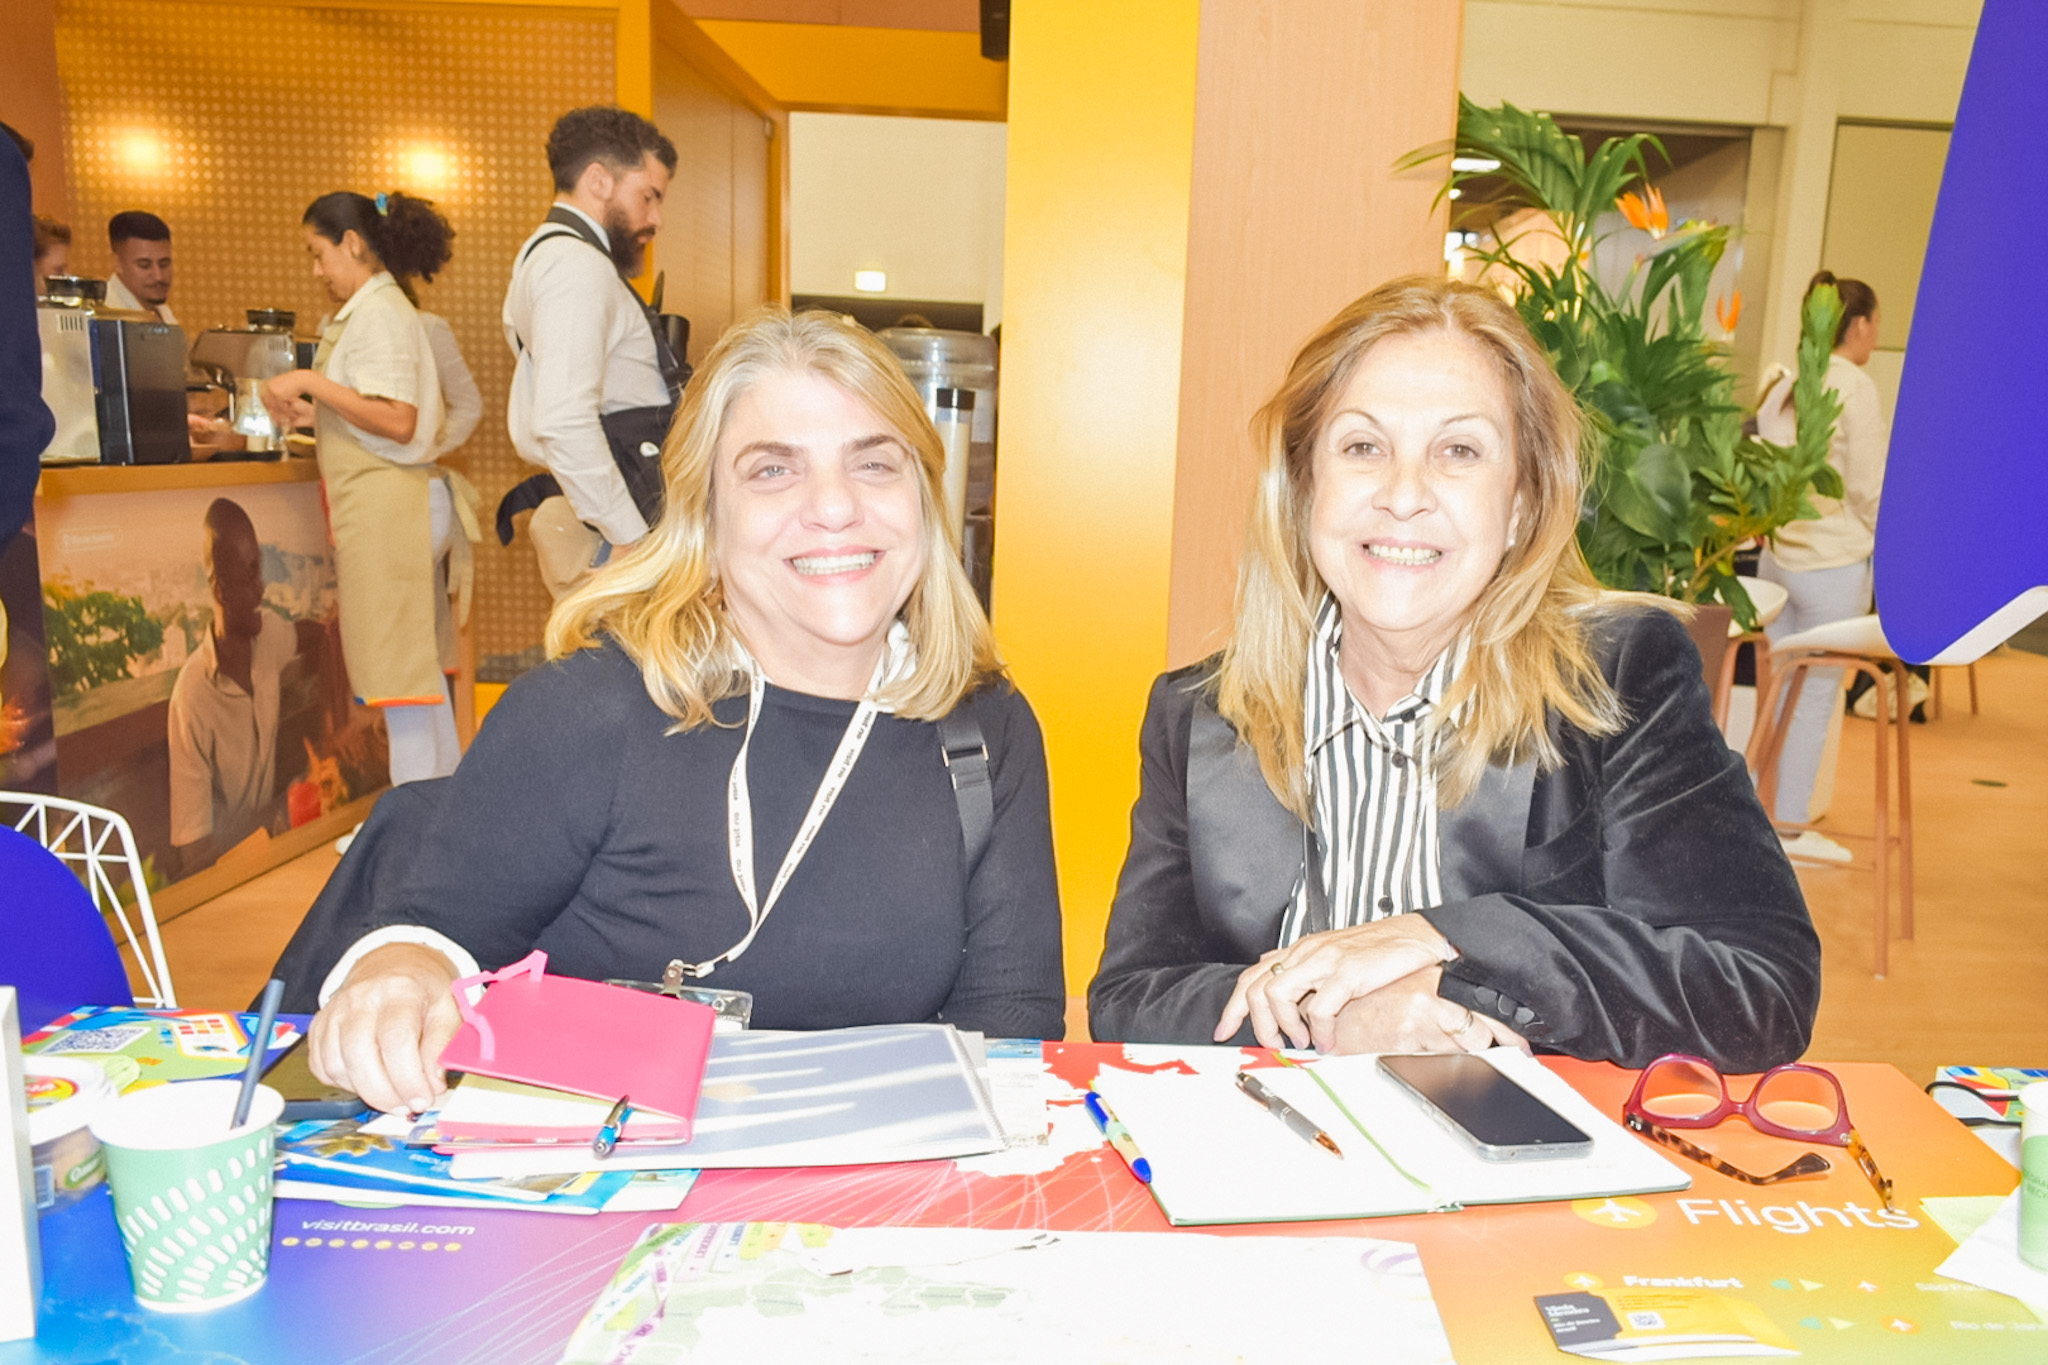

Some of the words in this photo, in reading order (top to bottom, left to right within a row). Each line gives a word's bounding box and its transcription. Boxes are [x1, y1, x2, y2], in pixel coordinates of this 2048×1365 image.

[1676, 1198, 1920, 1235] Flights
[301, 1219, 477, 1235] visitbrasil.com
[1622, 1275, 1745, 1289] Frankfurt
